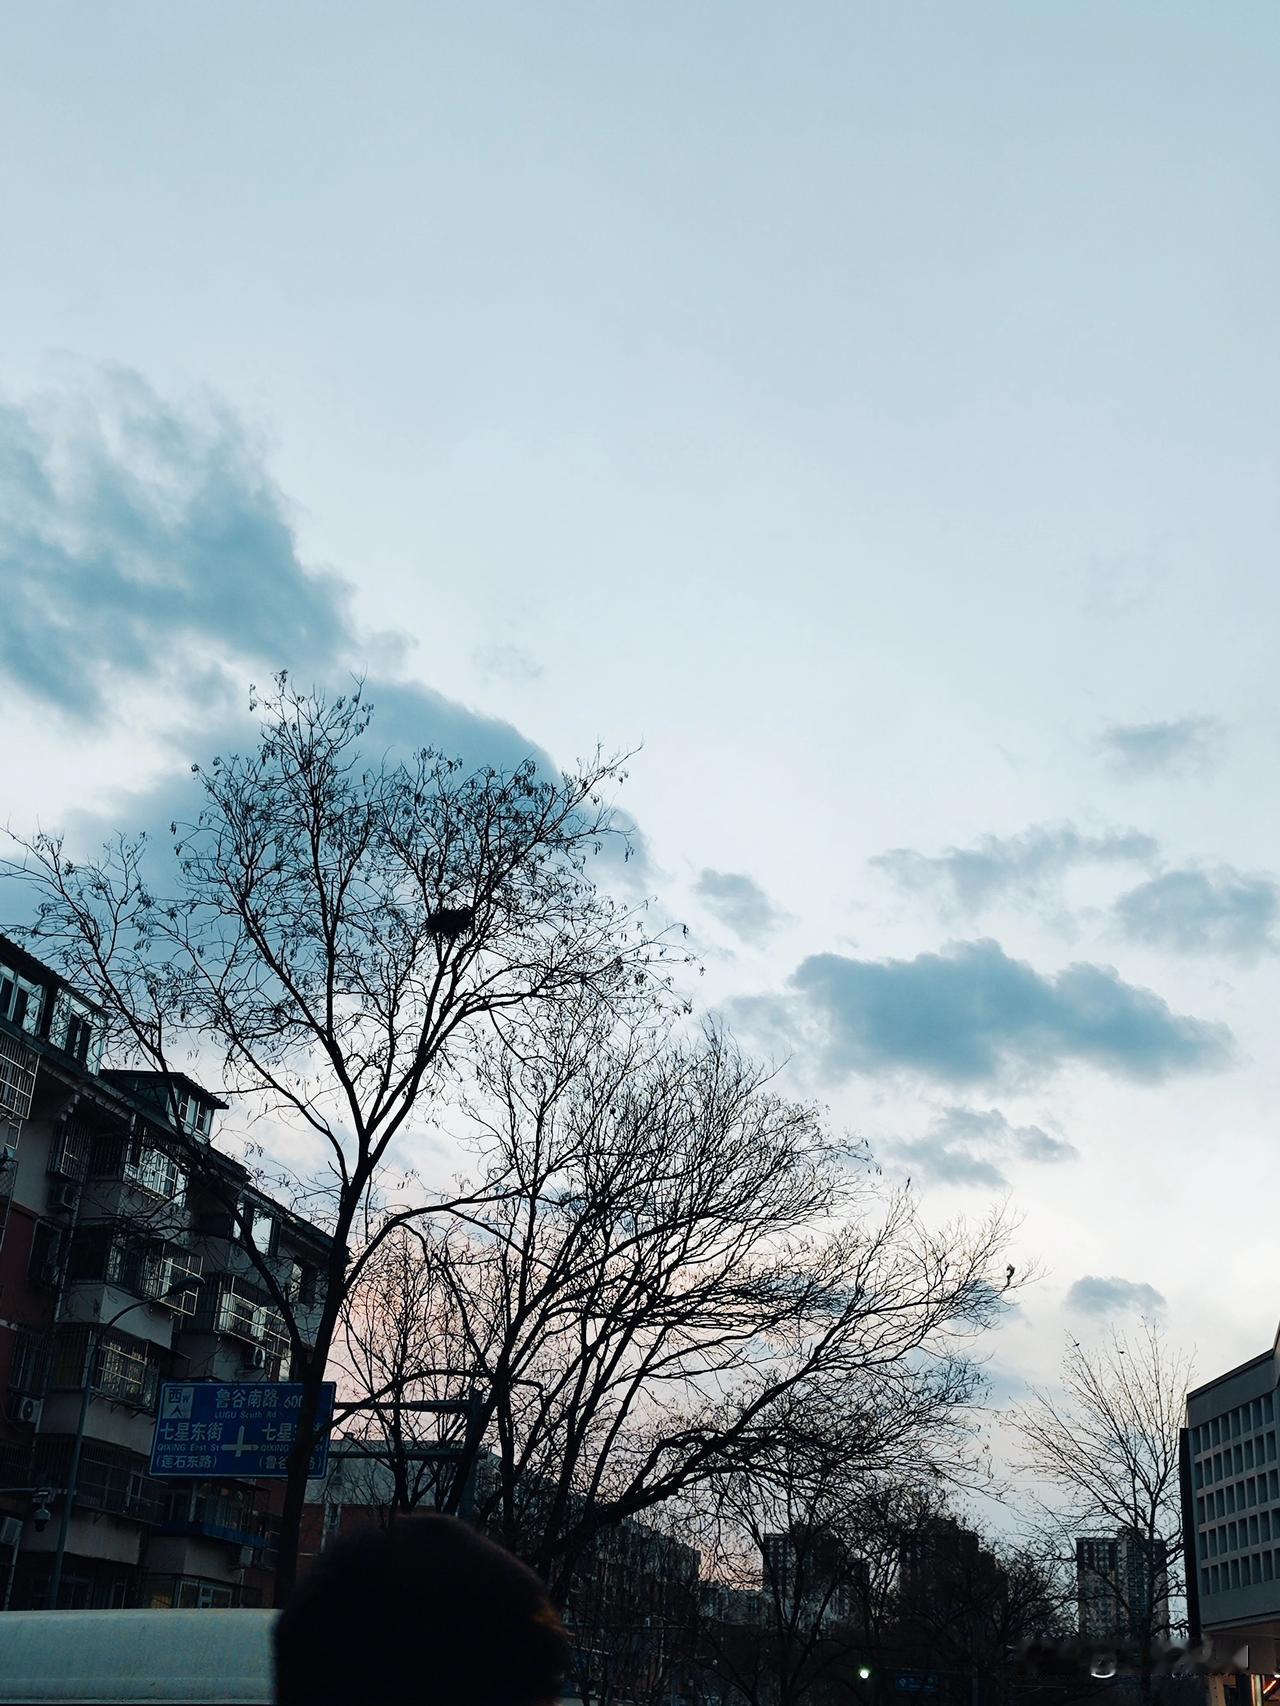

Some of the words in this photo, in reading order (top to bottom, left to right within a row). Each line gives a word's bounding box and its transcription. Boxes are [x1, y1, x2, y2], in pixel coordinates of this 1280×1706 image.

[168, 1388, 182, 1403] 西
[215, 1388, 279, 1408] 鲁谷南路
[214, 1410, 237, 1419] LUGU
[160, 1421, 224, 1441] 七星东街
